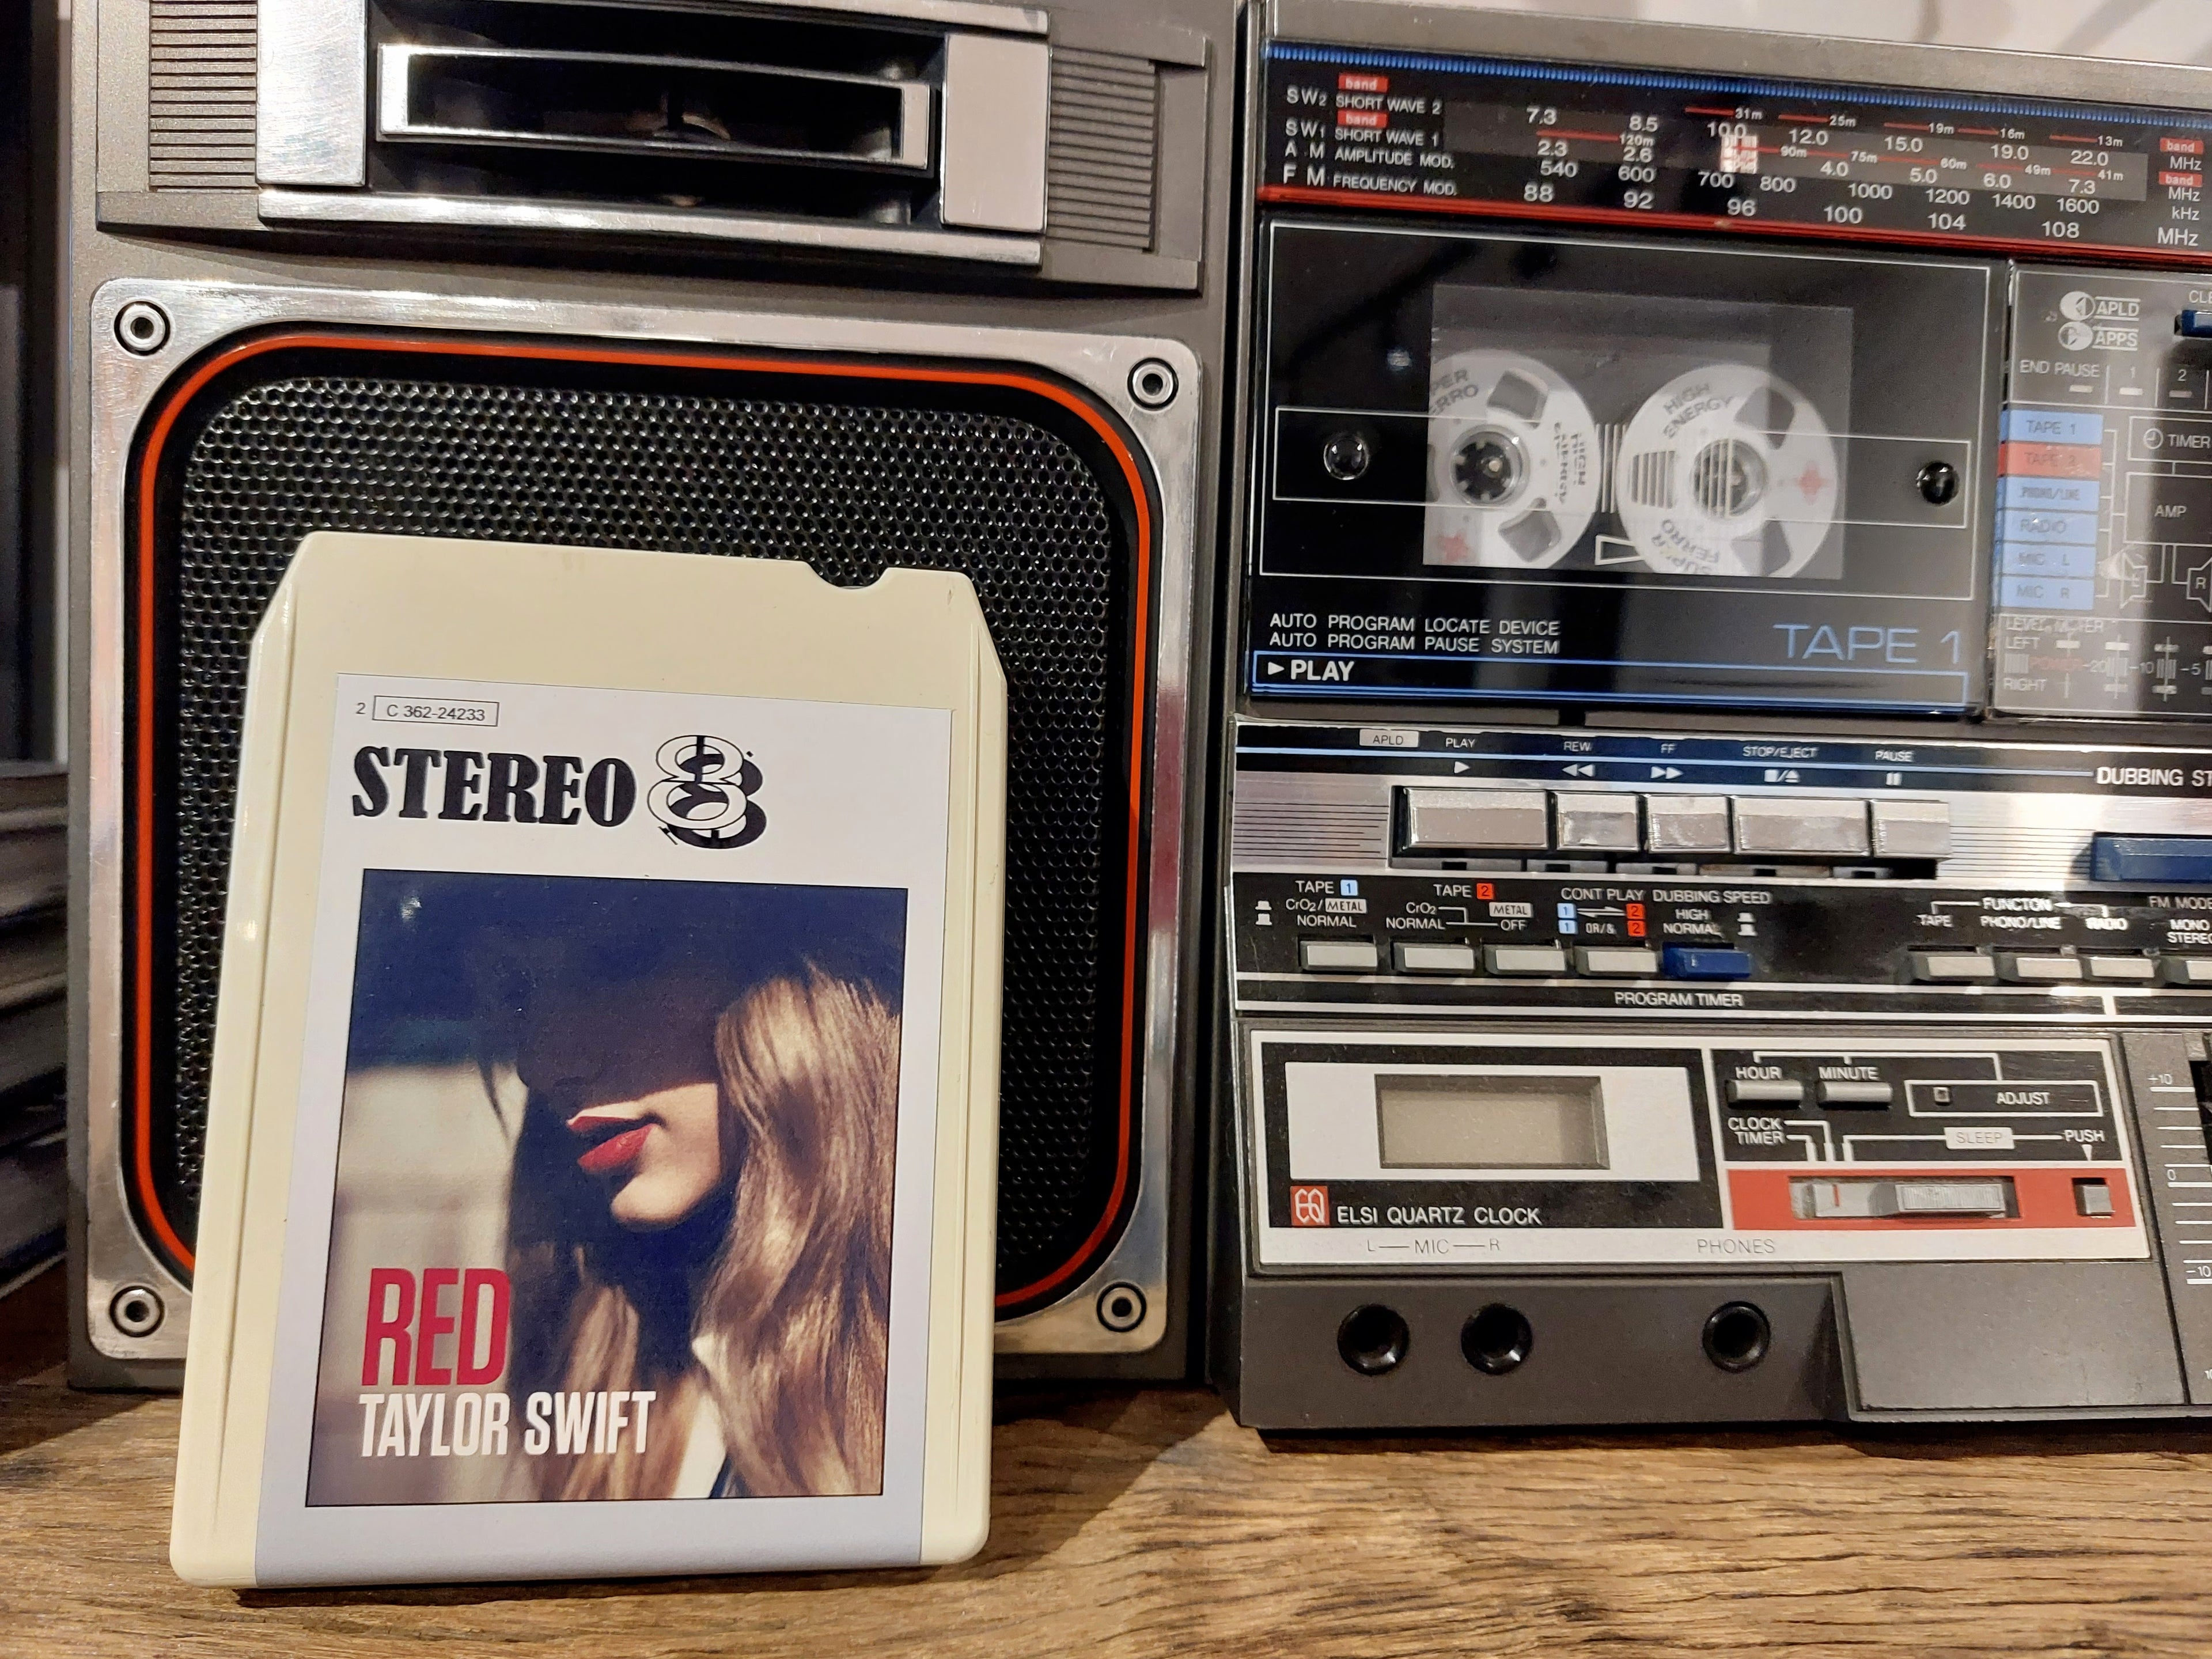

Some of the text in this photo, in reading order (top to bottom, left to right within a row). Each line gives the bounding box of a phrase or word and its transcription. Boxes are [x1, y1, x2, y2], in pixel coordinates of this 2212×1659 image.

[1345, 76, 1378, 90] band
[1335, 93, 1442, 115] SHORT WAVE 2
[1345, 114, 1378, 126] band
[1735, 107, 1763, 120] 31m
[1830, 115, 1856, 128] 25m
[1929, 123, 1955, 135] 19m
[1999, 128, 2025, 140] 16m
[1335, 128, 1438, 147] SHORT WAVE 1
[1526, 107, 2202, 172] 7.3 8.5 10.0 12.0 15.0 19.0 22.0 MHz
[1619, 134, 1654, 147] 120m
[2098, 136, 2123, 147] 13m
[1781, 145, 1807, 158] 90m
[2166, 141, 2194, 152] band
[1335, 146, 1455, 170] AMPLITUDE MOD.
[1851, 150, 1877, 163] 75m
[1537, 139, 1567, 157] 2.3
[1821, 161, 1849, 177] 4.0
[1910, 166, 1937, 183] 5.0
[1983, 173, 2012, 189] 6.0
[2068, 179, 2096, 195] 7.3
[2168, 187, 2200, 202] MHz
[2025, 164, 2051, 176] 49m
[2098, 170, 2123, 181] 41m
[1333, 172, 1458, 196] FREQUENCY MOD.
[2165, 174, 2193, 185] band
[1540, 160, 2200, 222] 540 600 700 800 1000 1200 1400 1600 kHz
[1524, 183, 2198, 247] 88 92 96 100 104 108 MHz
[2096, 301, 2139, 316] APLD
[2095, 331, 2138, 347] APPS
[2020, 360, 2100, 377] END PAUSE
[2130, 366, 2136, 378] 1
[2178, 369, 2187, 381] 2
[2027, 420, 2061, 435] TAPE
[2168, 434, 2211, 449] TIMER
[2154, 505, 2187, 518] AMP
[2195, 577, 2206, 589] R
[1270, 613, 1560, 636] AUTO PROGRAM LOCATE DEVICE
[1270, 632, 1560, 655] AUTO PROGRAM PAUSE SYSTEM
[1772, 623, 1960, 665] TAPE 1
[1290, 660, 1355, 682] PLAY
[357, 703, 365, 715] 2
[387, 705, 486, 722] C 362-24233
[1373, 734, 1403, 745] APLD
[1446, 738, 1476, 749] PLAY
[1563, 741, 1590, 752] REW
[1661, 743, 1676, 754] FF
[1743, 746, 1819, 759] STOP/EJECT
[1875, 749, 1914, 762] PAUSE
[2096, 766, 2183, 786] DUBBING
[352, 734, 767, 849] STEREO 8
[1295, 880, 1335, 894] TAPE
[1433, 884, 1489, 898] TAPE 2
[1561, 888, 1643, 902] CONT PLAY
[1653, 889, 1772, 905] DUBBING SPEED
[1327, 901, 1363, 912] METAL
[2149, 896, 2170, 908] FM
[1493, 904, 1528, 916] METAL
[1633, 907, 1639, 916] 2
[1675, 909, 1711, 921] HIGH
[1297, 915, 1357, 927] NORMAL
[1386, 918, 1446, 930] NORMAL
[1501, 919, 1526, 931] OFF
[1918, 914, 1953, 927] TAPE
[2085, 917, 2129, 930] RADIO
[2170, 919, 2210, 931] MONO
[1633, 923, 1640, 934] 2
[1615, 991, 1744, 1007] PROGRAM TIMER
[1736, 1067, 1782, 1080] HOUR
[1819, 1067, 1879, 1080] MINUTE
[2147, 1074, 2173, 1086] +10
[1996, 1092, 2050, 1105] ADJUST
[1728, 1118, 1784, 1131] CLOCK
[1735, 1131, 1785, 1145] TIMER
[1956, 1132, 2002, 1144] SLEEP
[2065, 1130, 2104, 1142] PUSH
[2166, 1169, 2176, 1181] 0
[1338, 1206, 1541, 1226] ELSI QUARTZ CLOCK
[1368, 1239, 1500, 1253] L MIC R
[1698, 1239, 1775, 1255] PHONES
[2186, 1266, 2211, 1277] -10
[362, 1268, 511, 1385] RED
[359, 1391, 656, 1457] TAYLOR SWIFT
